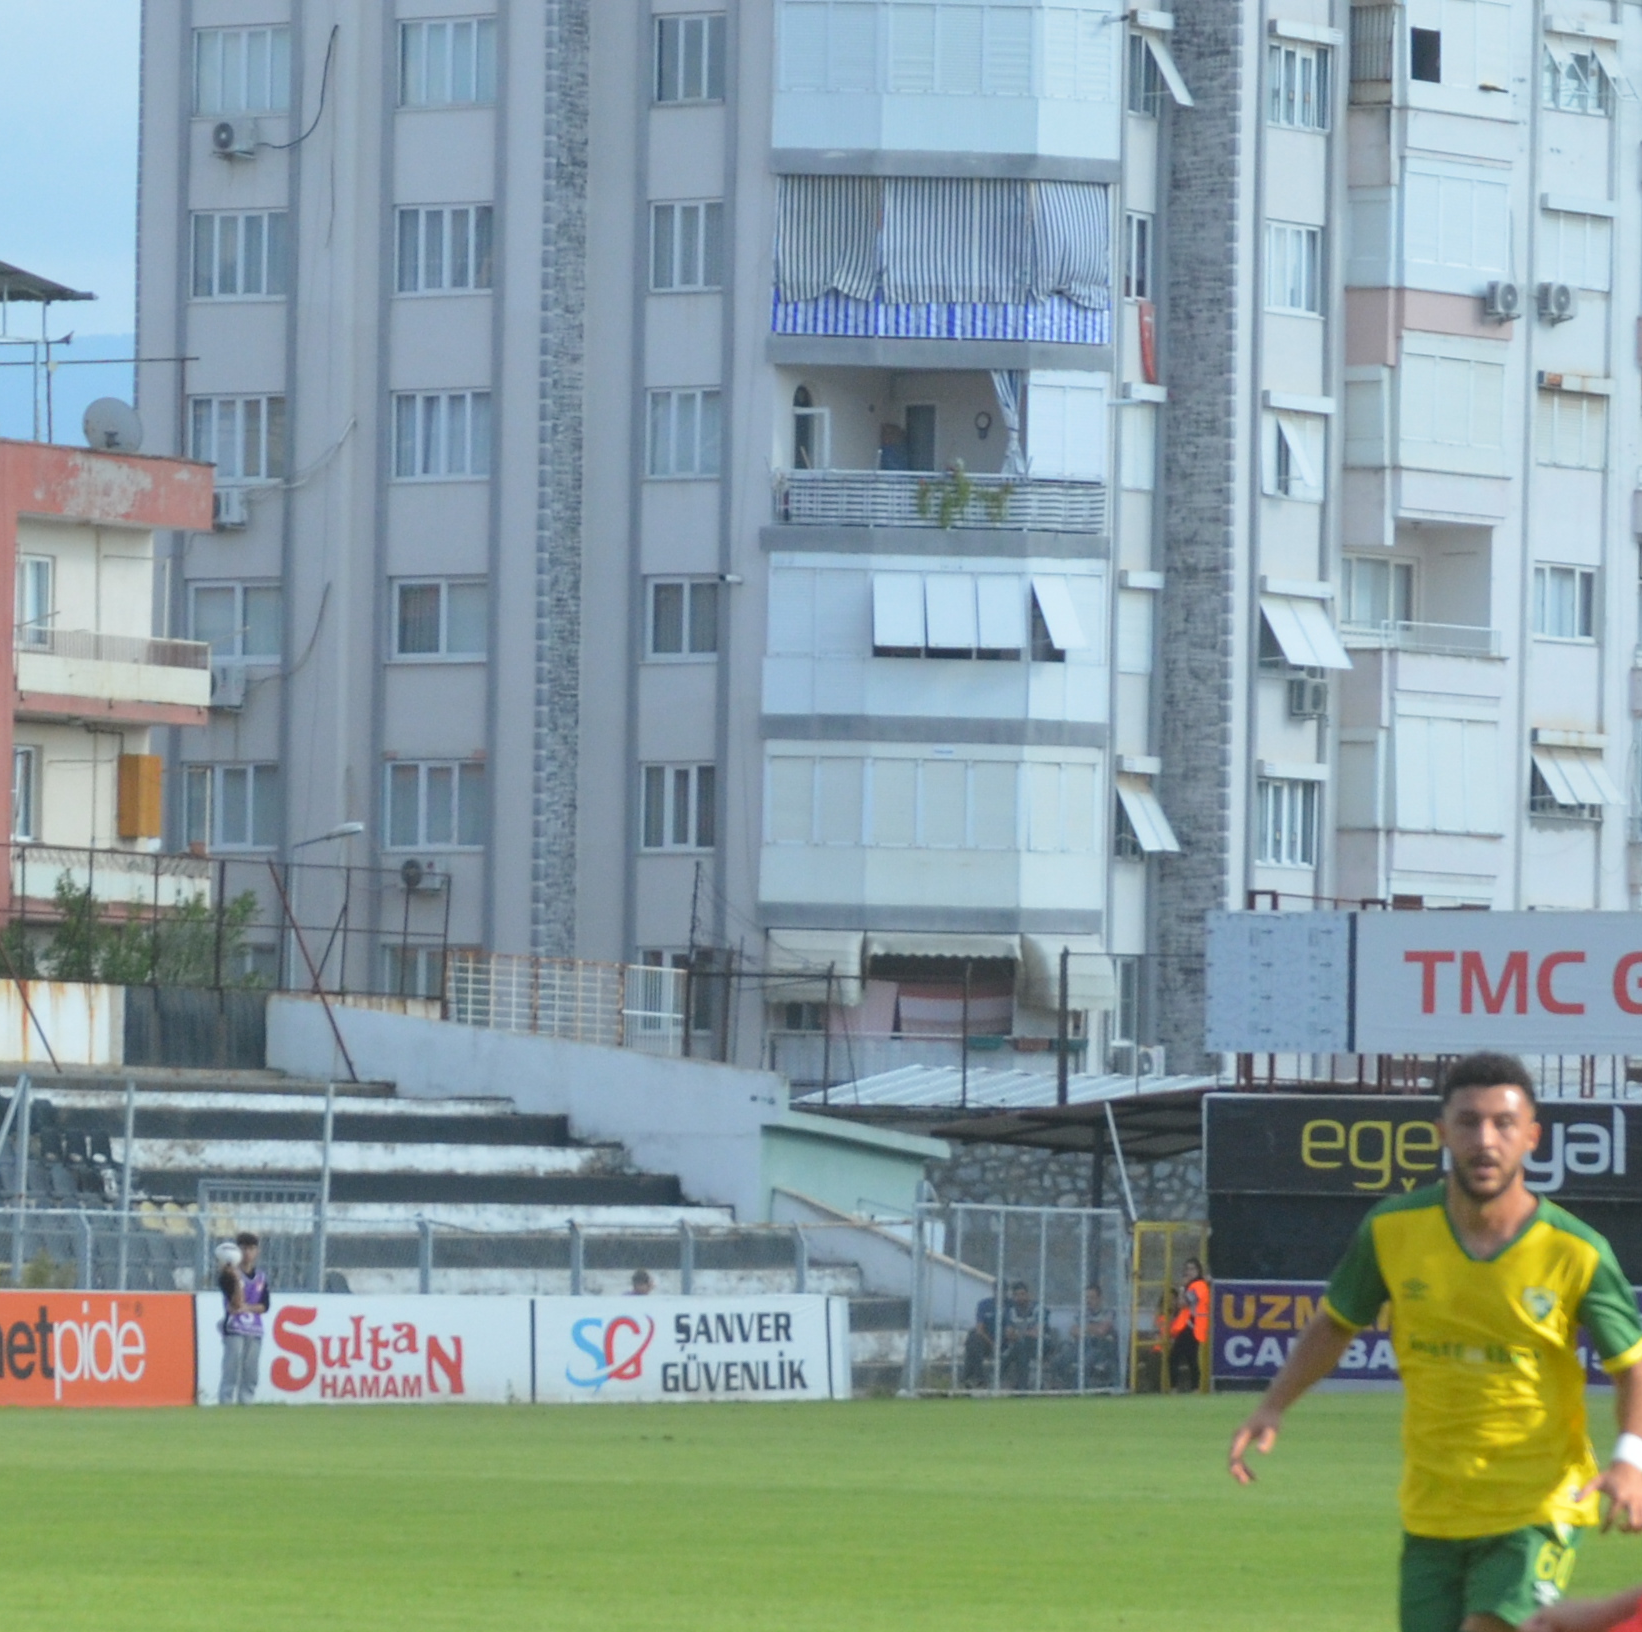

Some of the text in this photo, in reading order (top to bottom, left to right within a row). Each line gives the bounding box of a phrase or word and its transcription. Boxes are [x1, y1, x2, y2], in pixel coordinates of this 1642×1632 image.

[1404, 951, 1586, 1015] TMC
[1300, 1106, 1627, 1193] egeyal
[674, 1312, 794, 1352] ŞANVER
[319, 1374, 423, 1399] HAMAM
[661, 1351, 809, 1393] GÜVENLİK
